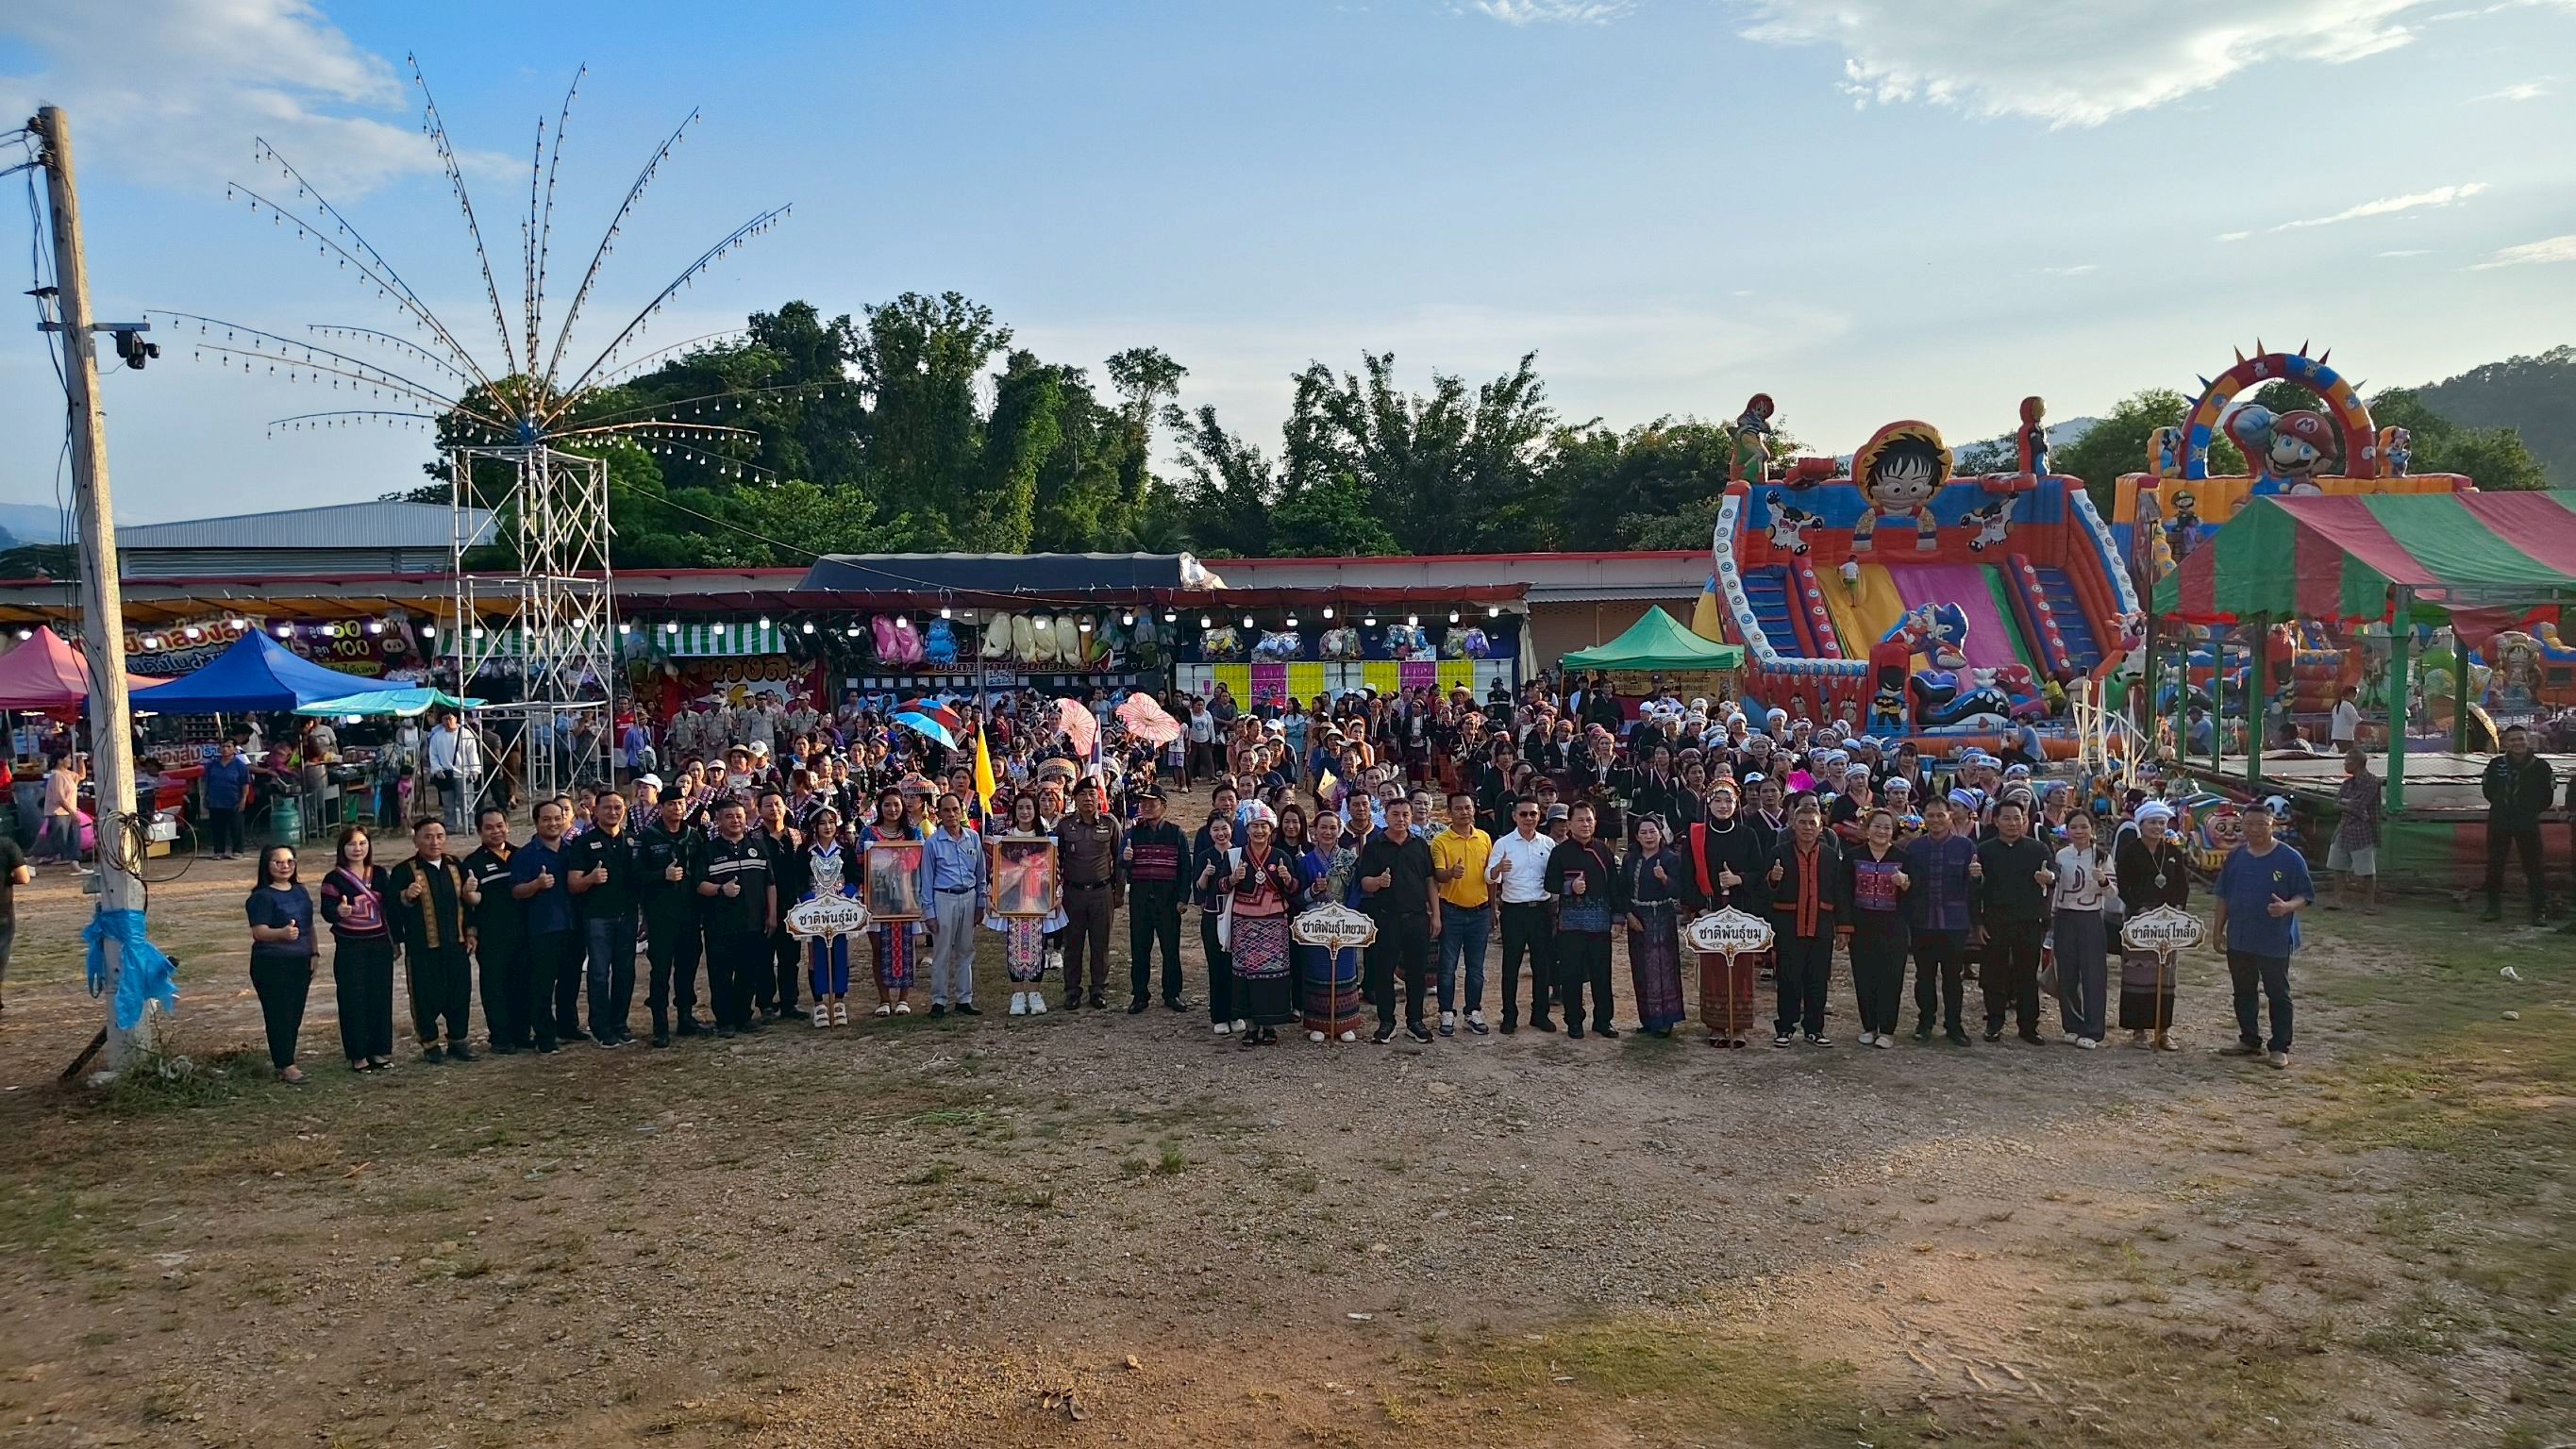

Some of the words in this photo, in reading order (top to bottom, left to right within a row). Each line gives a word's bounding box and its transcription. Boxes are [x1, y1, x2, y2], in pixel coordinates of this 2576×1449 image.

[332, 639, 370, 657] 100
[798, 908, 859, 925] ชาติพันธุ์ม้ง
[1302, 919, 1367, 937] ชาติพันธุ์ไทยวน
[1698, 923, 1762, 943] ชาติพันธุ์ขมุ
[2131, 920, 2197, 941] ชาติพันธุ์ไทลื้อ
